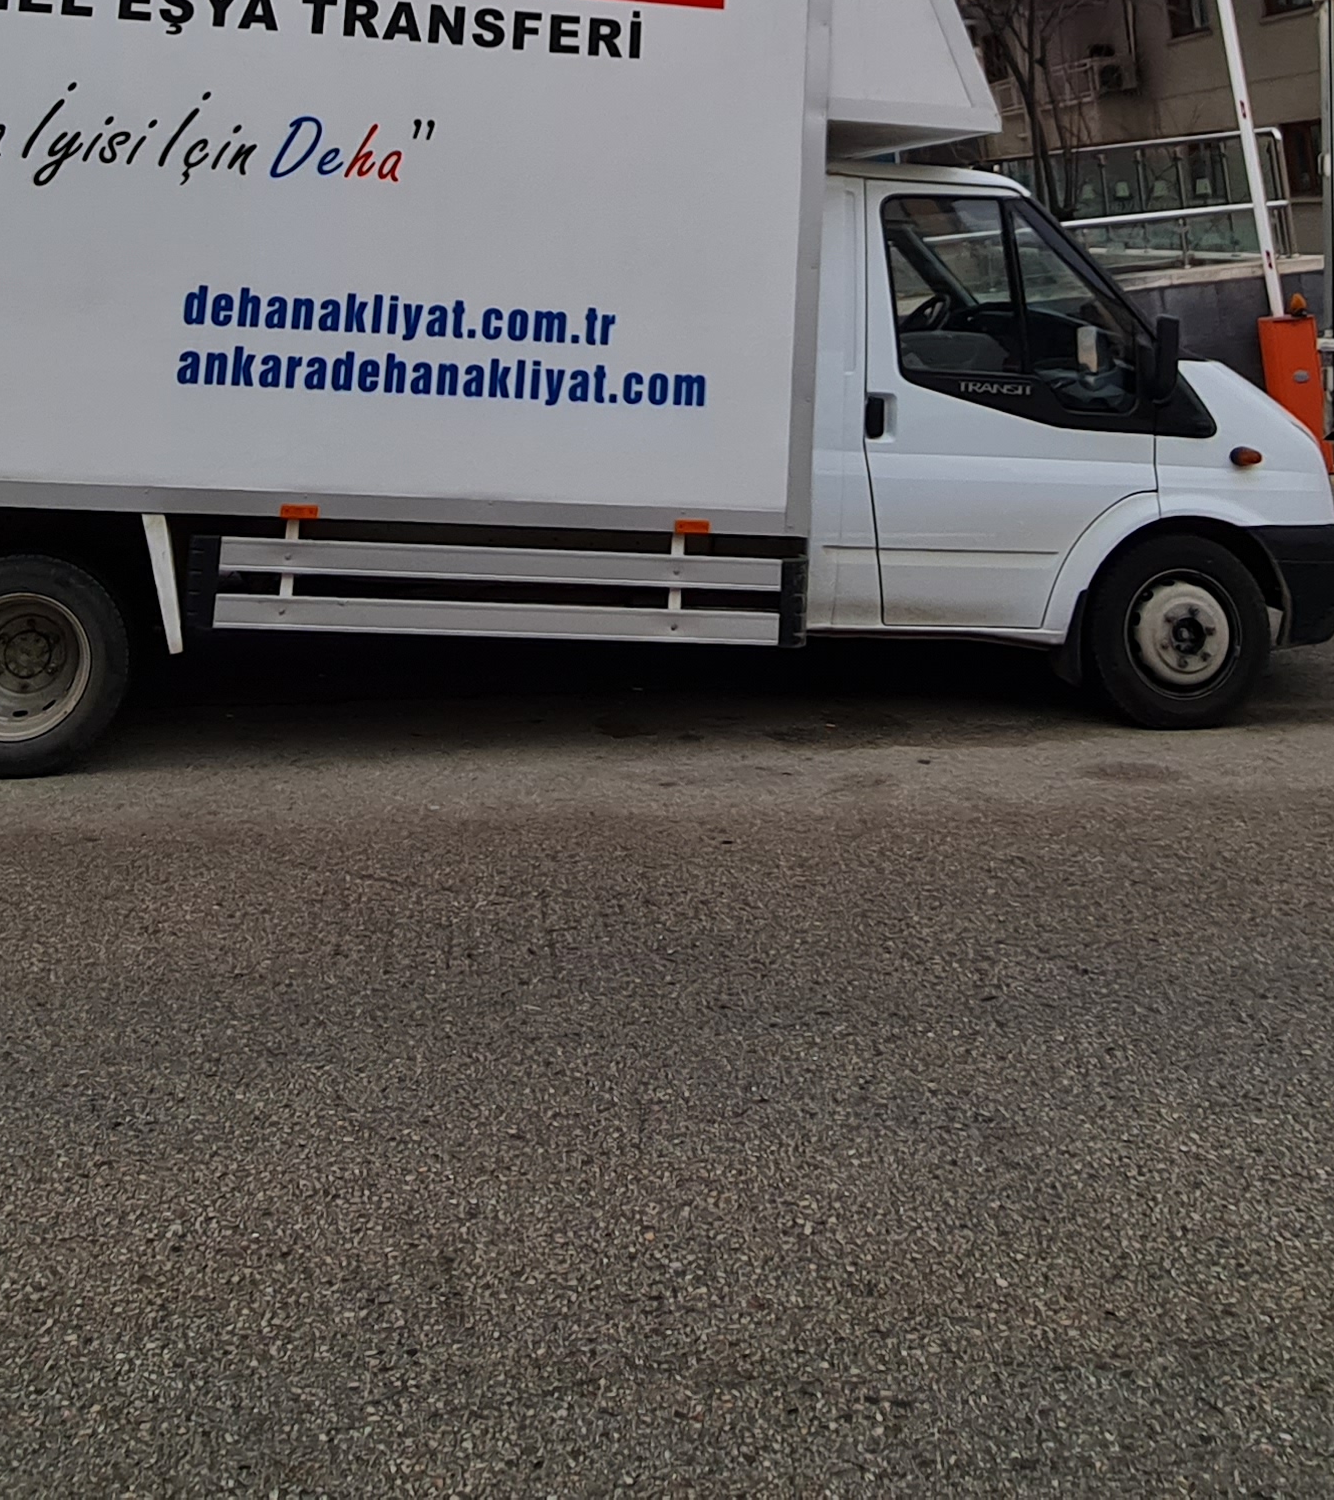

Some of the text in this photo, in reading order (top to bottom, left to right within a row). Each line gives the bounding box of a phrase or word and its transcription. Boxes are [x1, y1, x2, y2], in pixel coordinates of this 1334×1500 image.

[21, 81, 159, 187] İyisi
[158, 90, 259, 187] İçin
[183, 284, 617, 346] dehanakliyat.com.tr
[176, 346, 707, 407] ankaradehanakliyat.com
[959, 380, 1033, 396] TRANSIT
